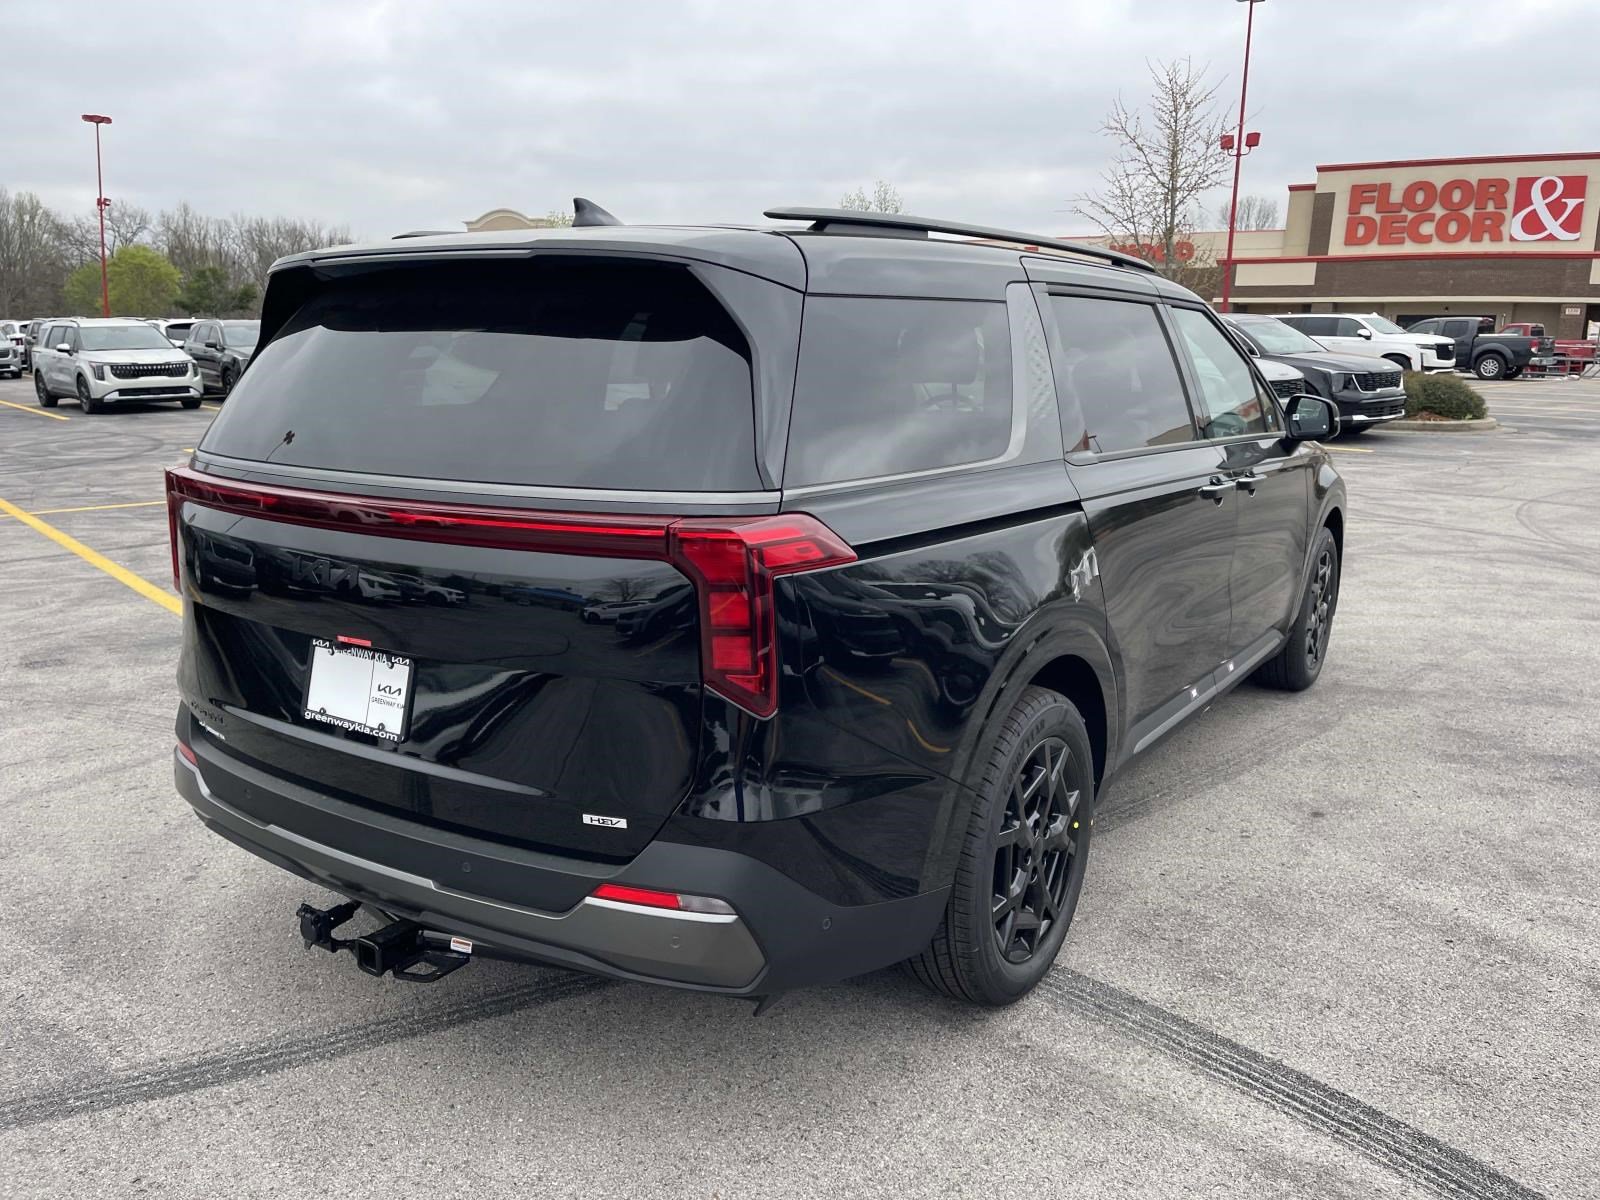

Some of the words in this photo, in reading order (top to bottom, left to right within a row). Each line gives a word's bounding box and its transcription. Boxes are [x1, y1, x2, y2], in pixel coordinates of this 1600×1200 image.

[1348, 178, 1511, 215] FLOOR
[1510, 175, 1585, 241] &
[1344, 211, 1506, 246] DECOR
[312, 639, 330, 648] KIA
[391, 656, 410, 666] KIA
[377, 683, 402, 696] KIA
[371, 696, 396, 707] GREENWAY
[304, 710, 398, 742] greenwaykia.com
